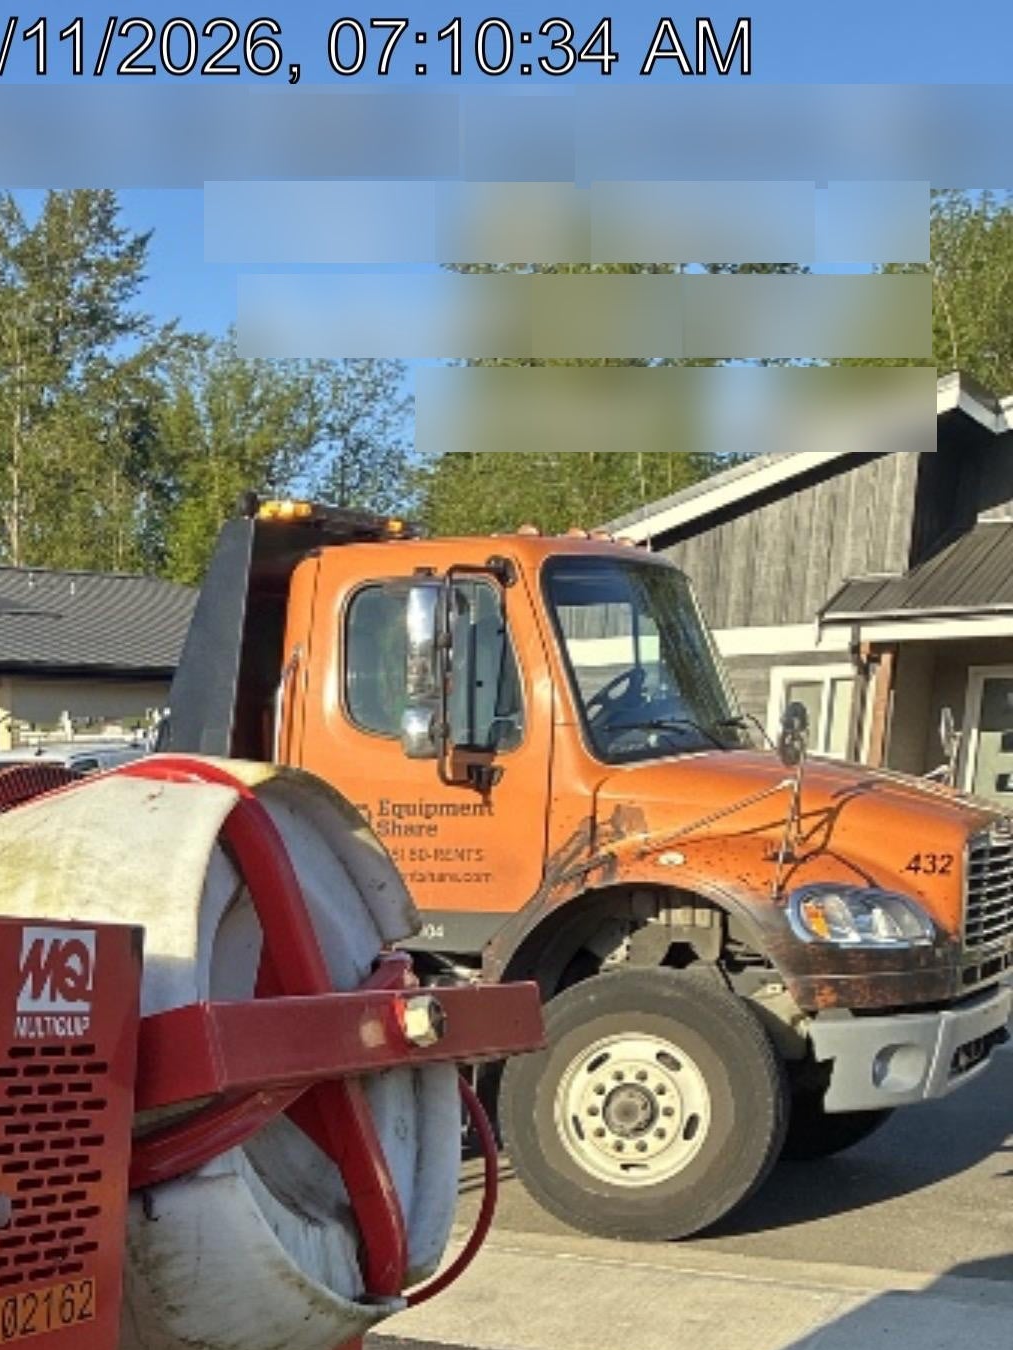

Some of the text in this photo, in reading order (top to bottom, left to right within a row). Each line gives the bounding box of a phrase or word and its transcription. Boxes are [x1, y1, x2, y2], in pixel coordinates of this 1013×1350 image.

[378, 800, 495, 818] Equipment
[377, 820, 438, 837] Share
[905, 853, 954, 874] 432
[17, 932, 95, 1006] MQ
